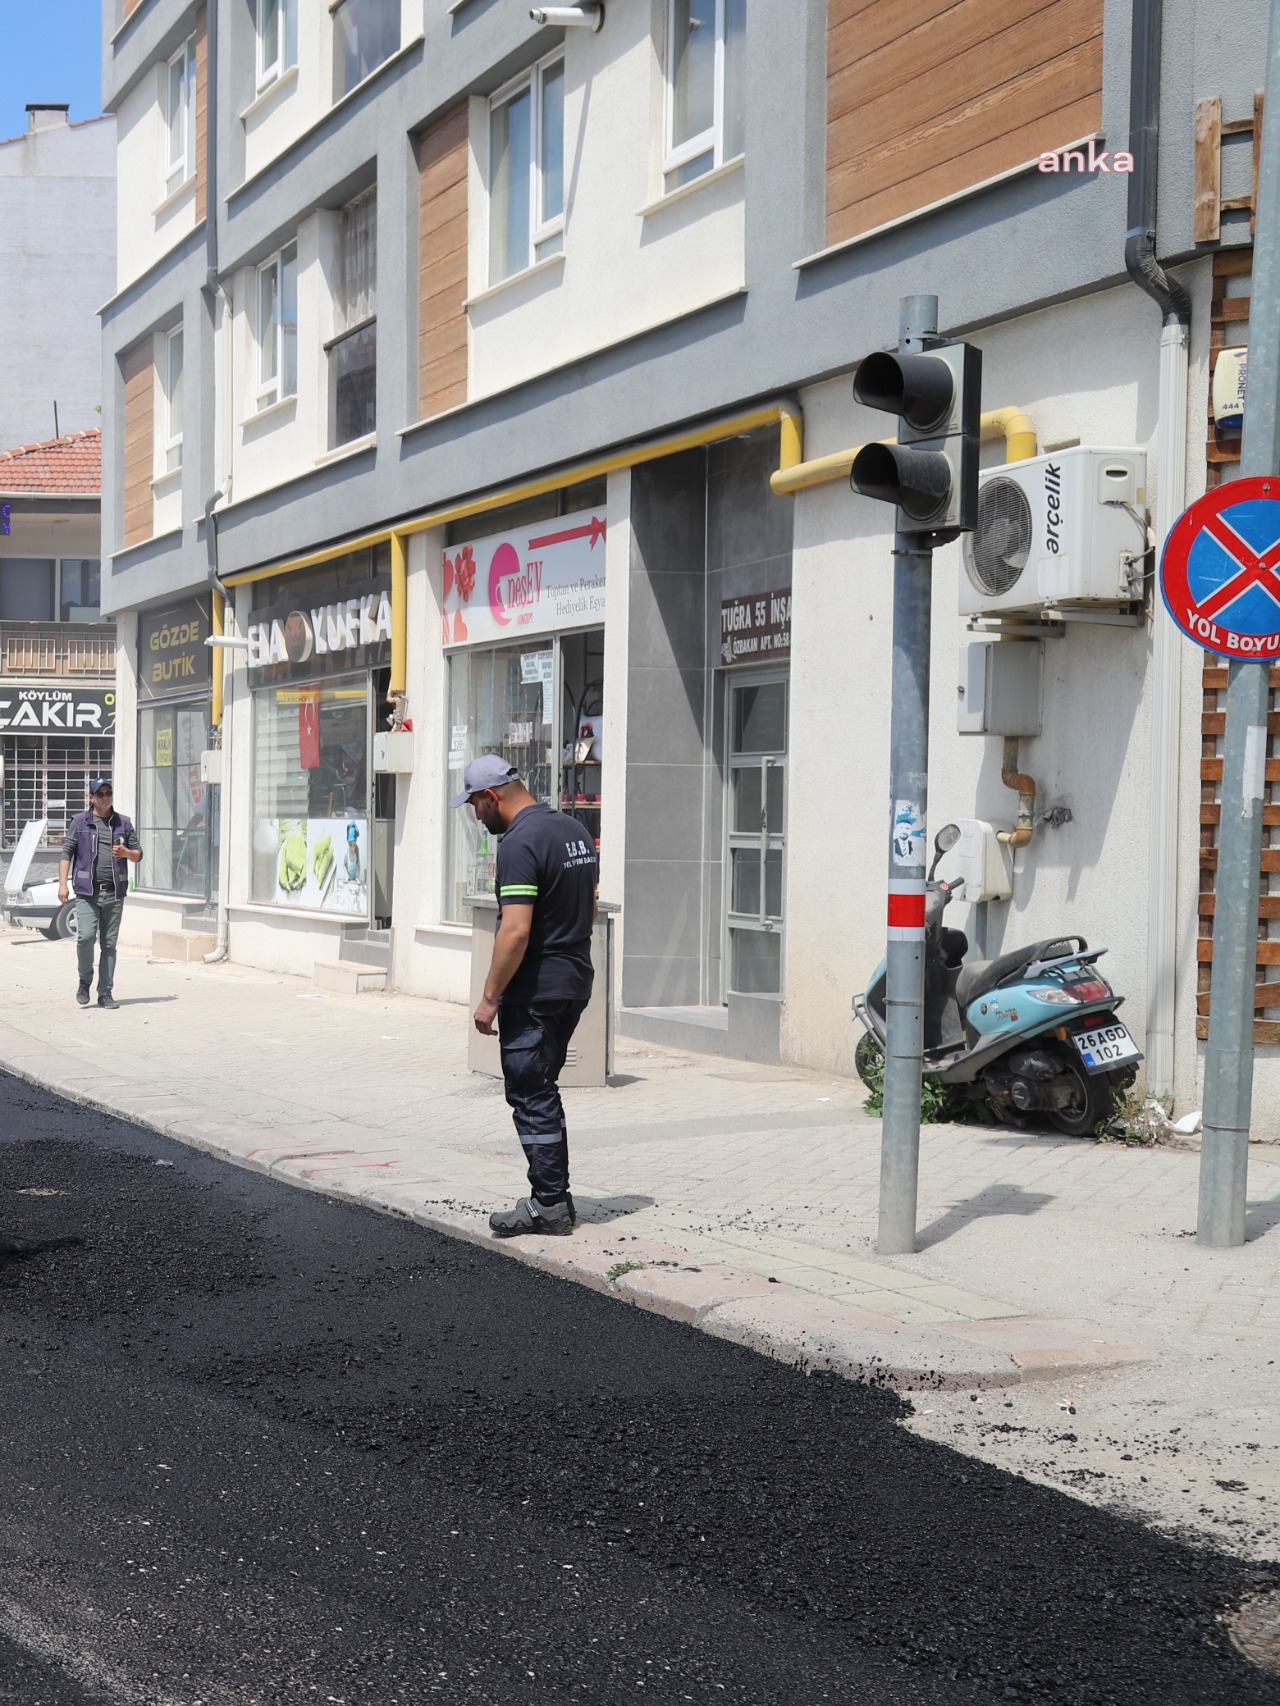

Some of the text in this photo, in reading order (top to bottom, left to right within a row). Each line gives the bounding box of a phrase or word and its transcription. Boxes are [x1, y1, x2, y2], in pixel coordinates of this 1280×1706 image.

[1237, 363, 1247, 400] PRONET
[1045, 462, 1064, 555] arçelik
[546, 584, 570, 600] Toptan
[570, 583, 579, 593] ve
[556, 595, 606, 617] Hediyelik Eşya
[722, 600, 752, 633] TUĞRA
[755, 600, 767, 627] 55
[310, 590, 393, 655] YUFKA
[1186, 607, 1280, 652] YOL BOYU
[149, 620, 200, 651] GÖZDE
[733, 637, 759, 655] ÖZBAKAN
[760, 635, 772, 651] APT.
[152, 652, 196, 682] BUTİK
[18, 690, 72, 702] KÖYLÜM
[104, 693, 116, 706] O
[565, 840, 590, 857] E.B.B.
[1078, 1026, 1127, 1050] 26 AGD
[1096, 1044, 1123, 1061] 102
